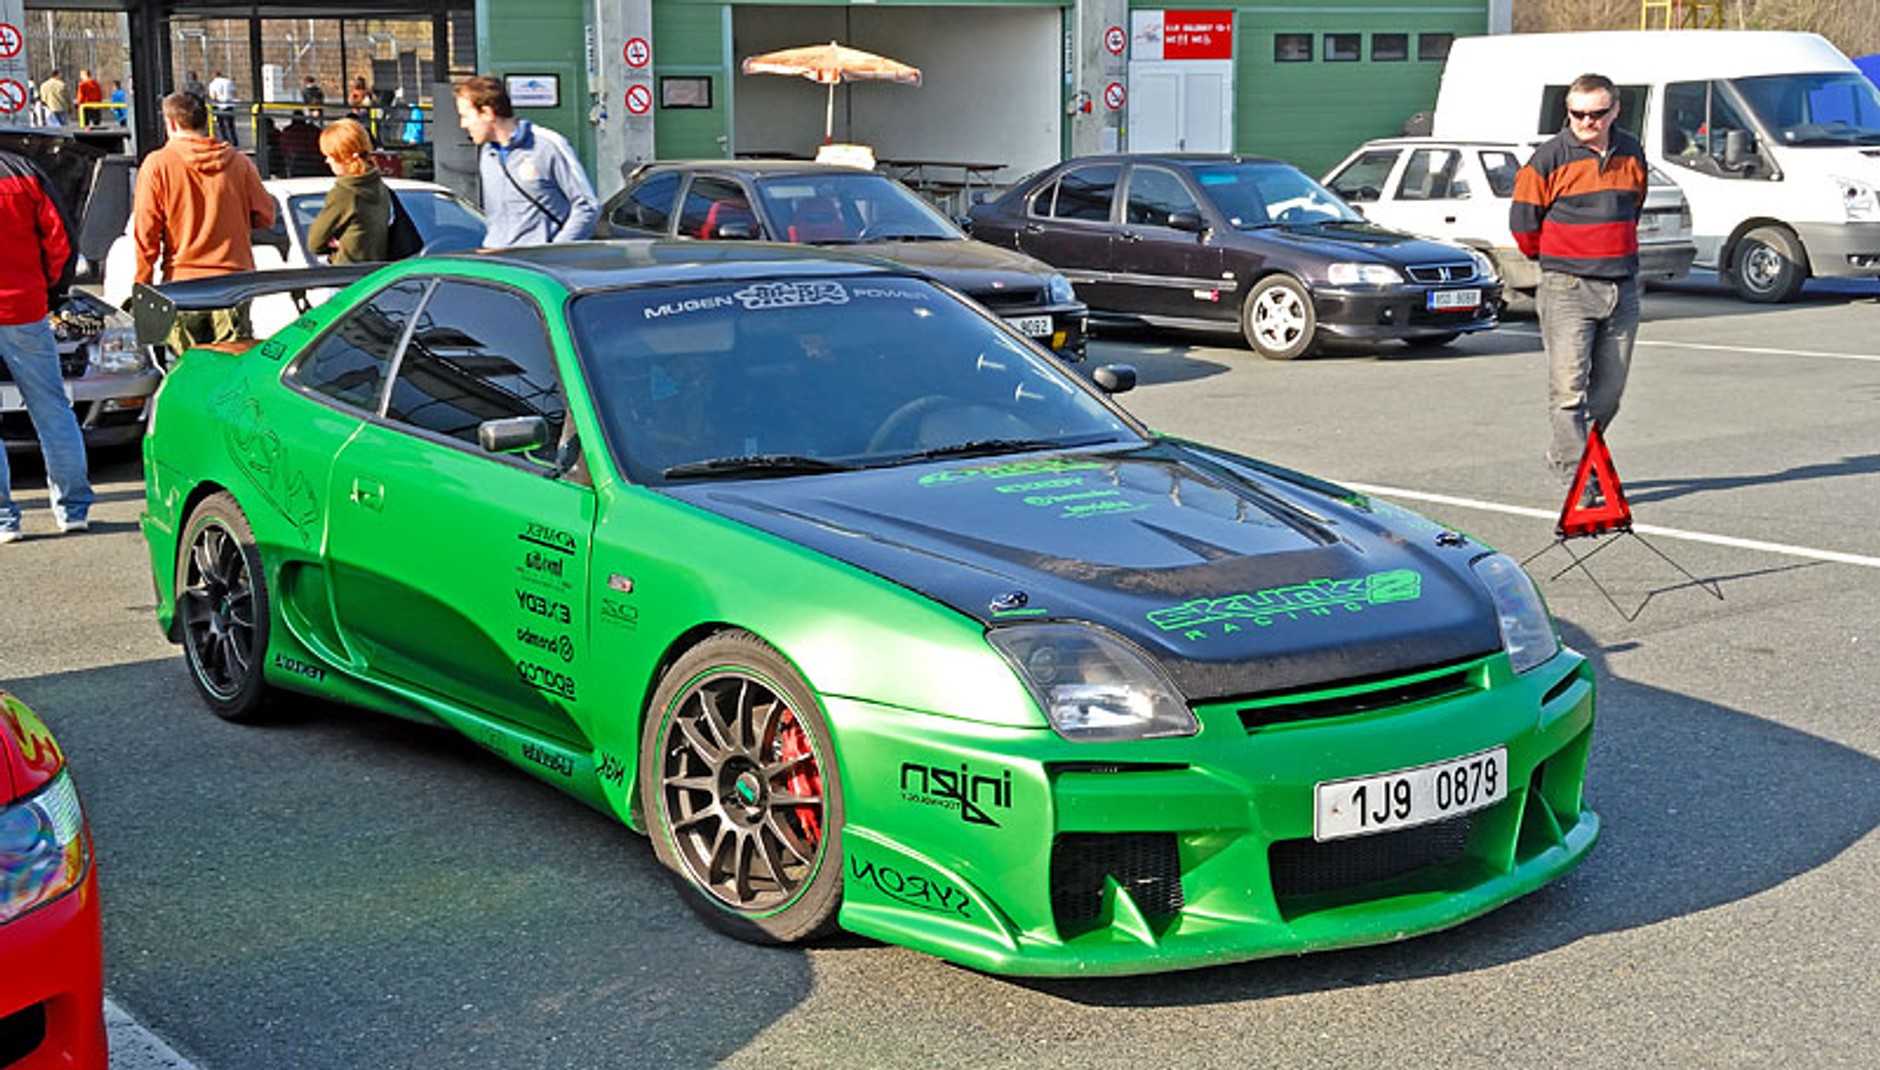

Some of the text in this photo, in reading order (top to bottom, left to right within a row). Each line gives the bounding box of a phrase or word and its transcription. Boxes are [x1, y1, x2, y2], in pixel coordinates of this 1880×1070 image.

[643, 294, 732, 319] MUGEN
[852, 287, 930, 300] POWER
[1184, 602, 1363, 641] RACING
[1351, 756, 1499, 827] 1J9 0879
